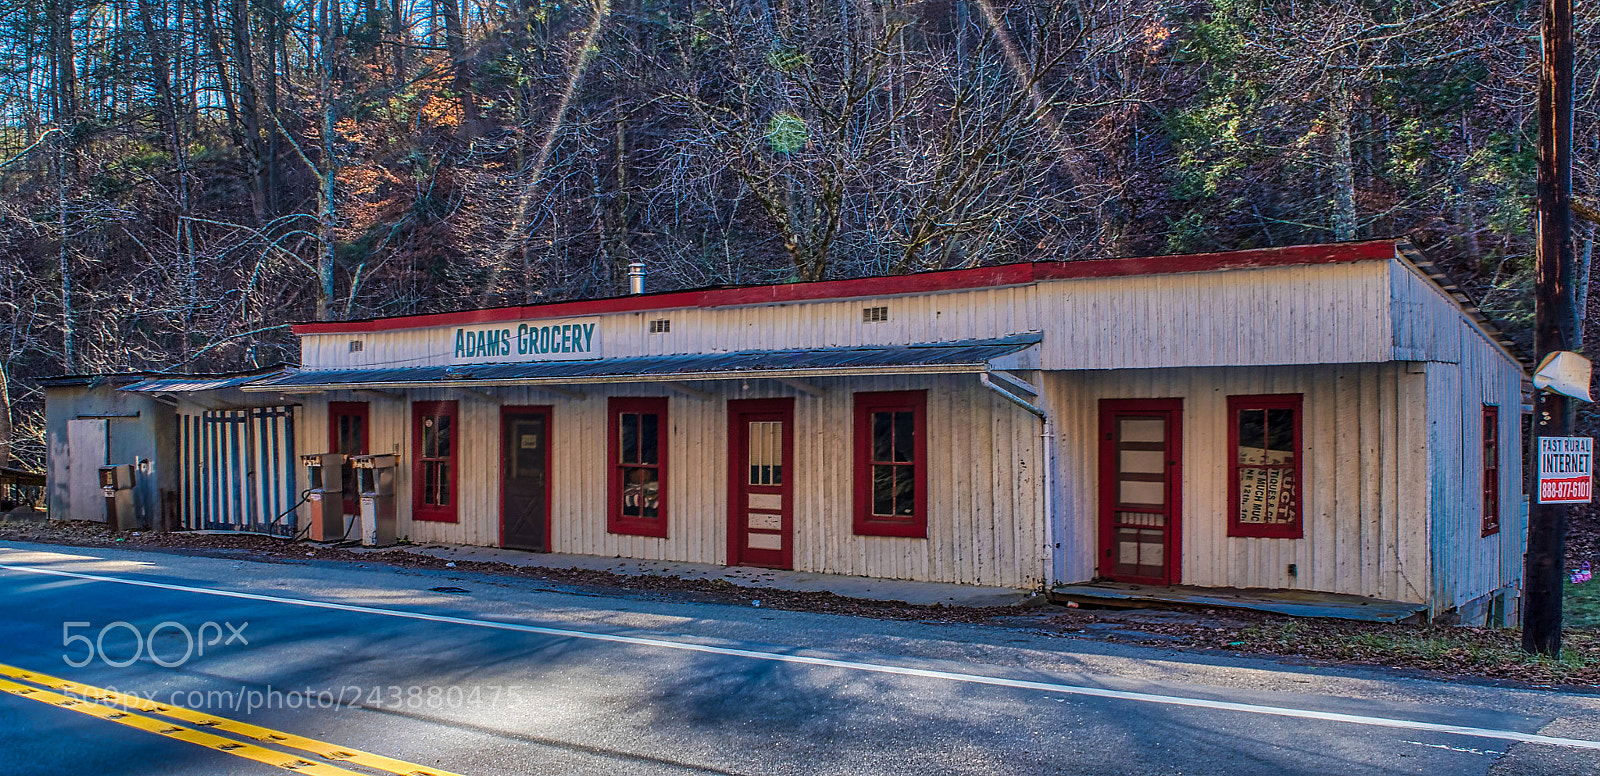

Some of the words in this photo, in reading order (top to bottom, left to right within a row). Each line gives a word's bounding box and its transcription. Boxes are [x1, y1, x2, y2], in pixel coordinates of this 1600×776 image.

[455, 328, 511, 358] ADAMS
[517, 323, 596, 355] GROCERY
[1542, 439, 1561, 452] FAST
[1564, 439, 1590, 452] RURAL
[1542, 453, 1590, 473] INTERNET
[1254, 478, 1266, 502] MUCH
[1542, 481, 1589, 498] 888-877-6101
